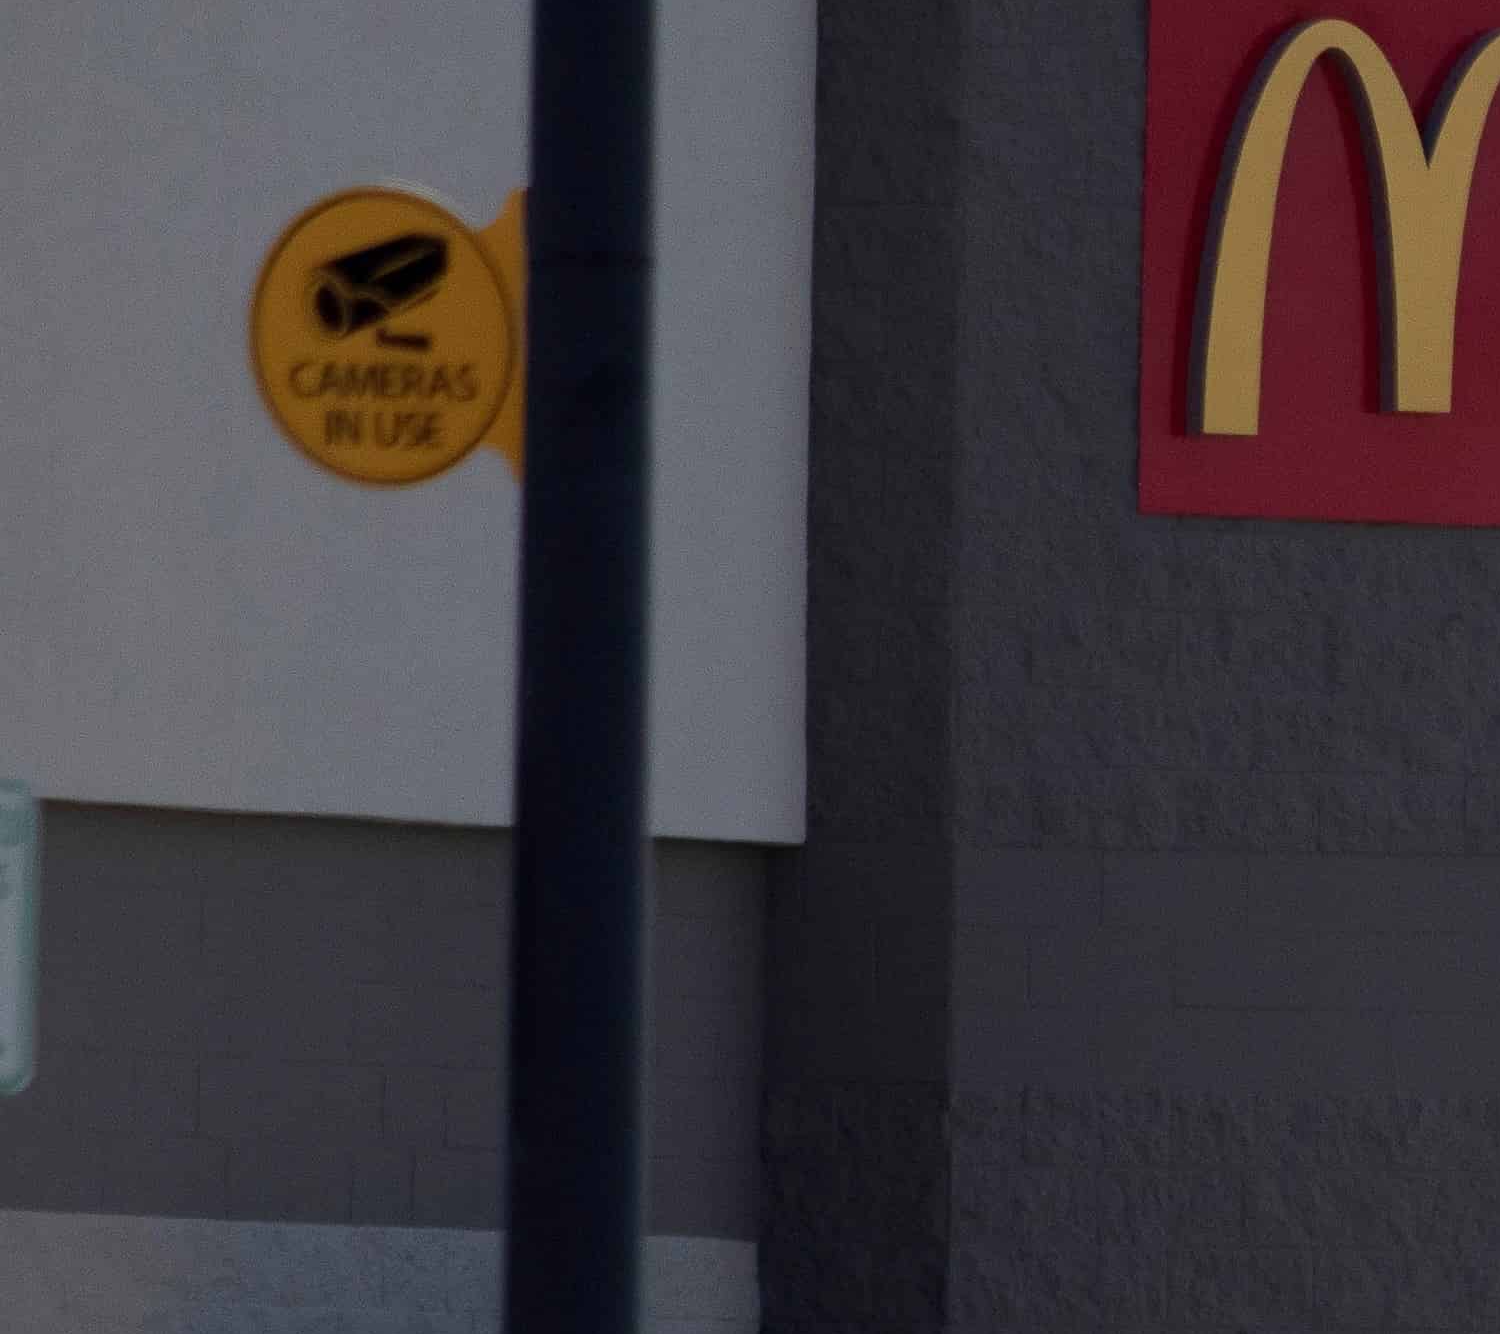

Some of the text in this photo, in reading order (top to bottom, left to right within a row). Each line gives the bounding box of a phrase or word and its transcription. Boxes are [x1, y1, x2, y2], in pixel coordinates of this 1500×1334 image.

[288, 363, 478, 403] CAMERAS
[324, 410, 442, 448] IN USE
